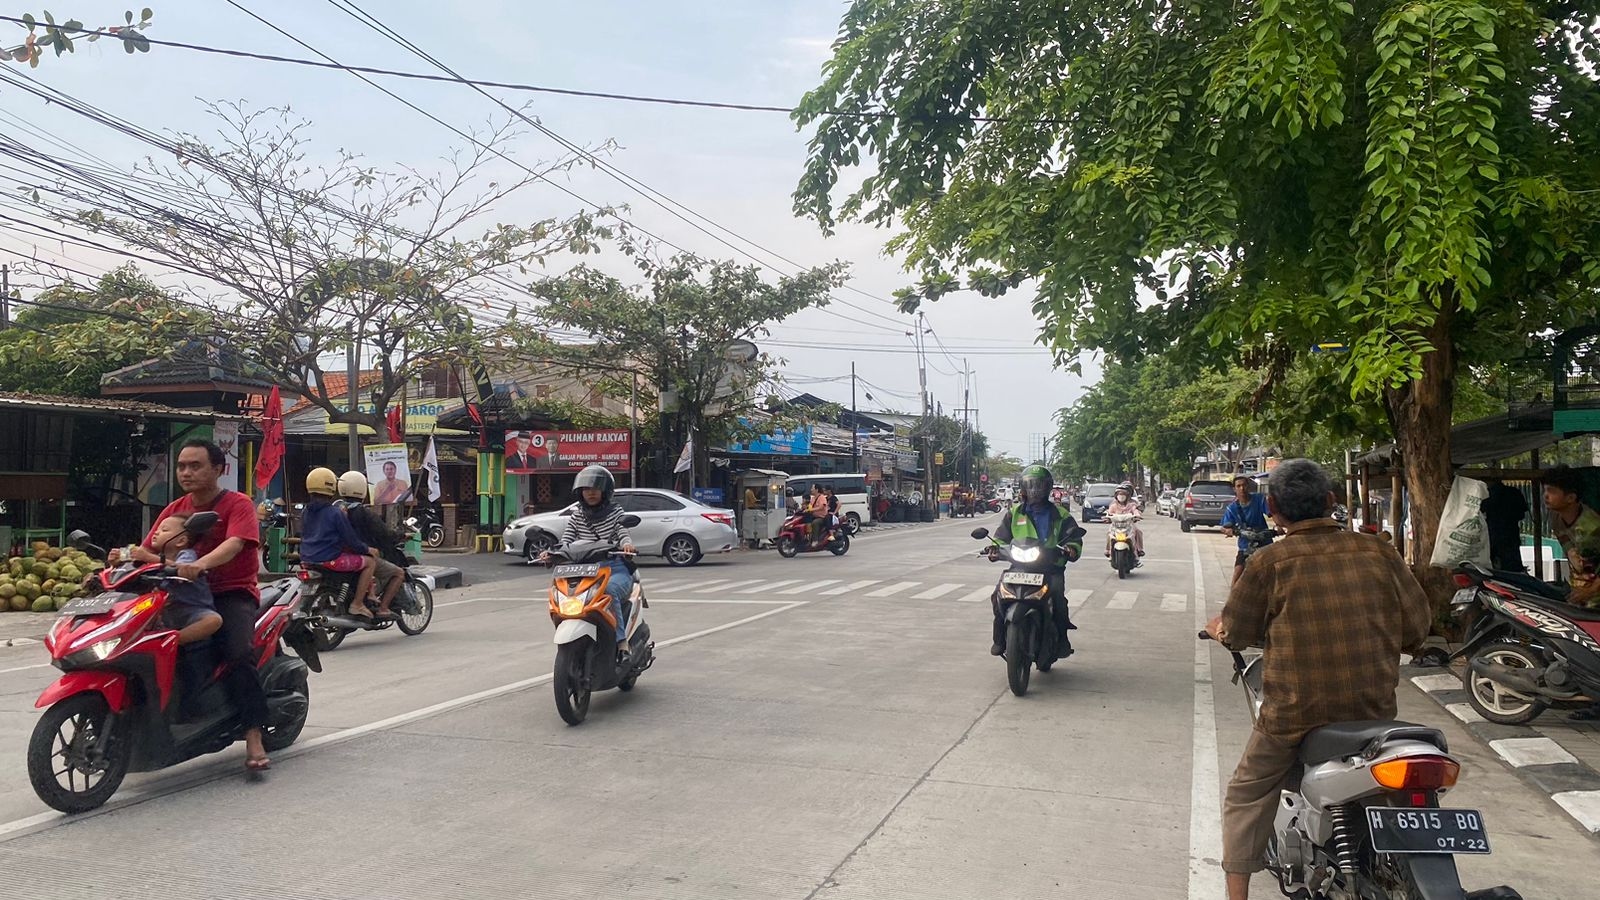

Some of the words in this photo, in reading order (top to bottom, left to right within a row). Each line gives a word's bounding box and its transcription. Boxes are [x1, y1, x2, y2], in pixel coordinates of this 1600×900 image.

[535, 437, 542, 445] 3
[560, 434, 594, 442] PILIHAN
[597, 433, 628, 442] RAKYAT
[1372, 811, 1384, 829] H
[1397, 812, 1442, 830] 6515
[1456, 813, 1479, 831] BQ
